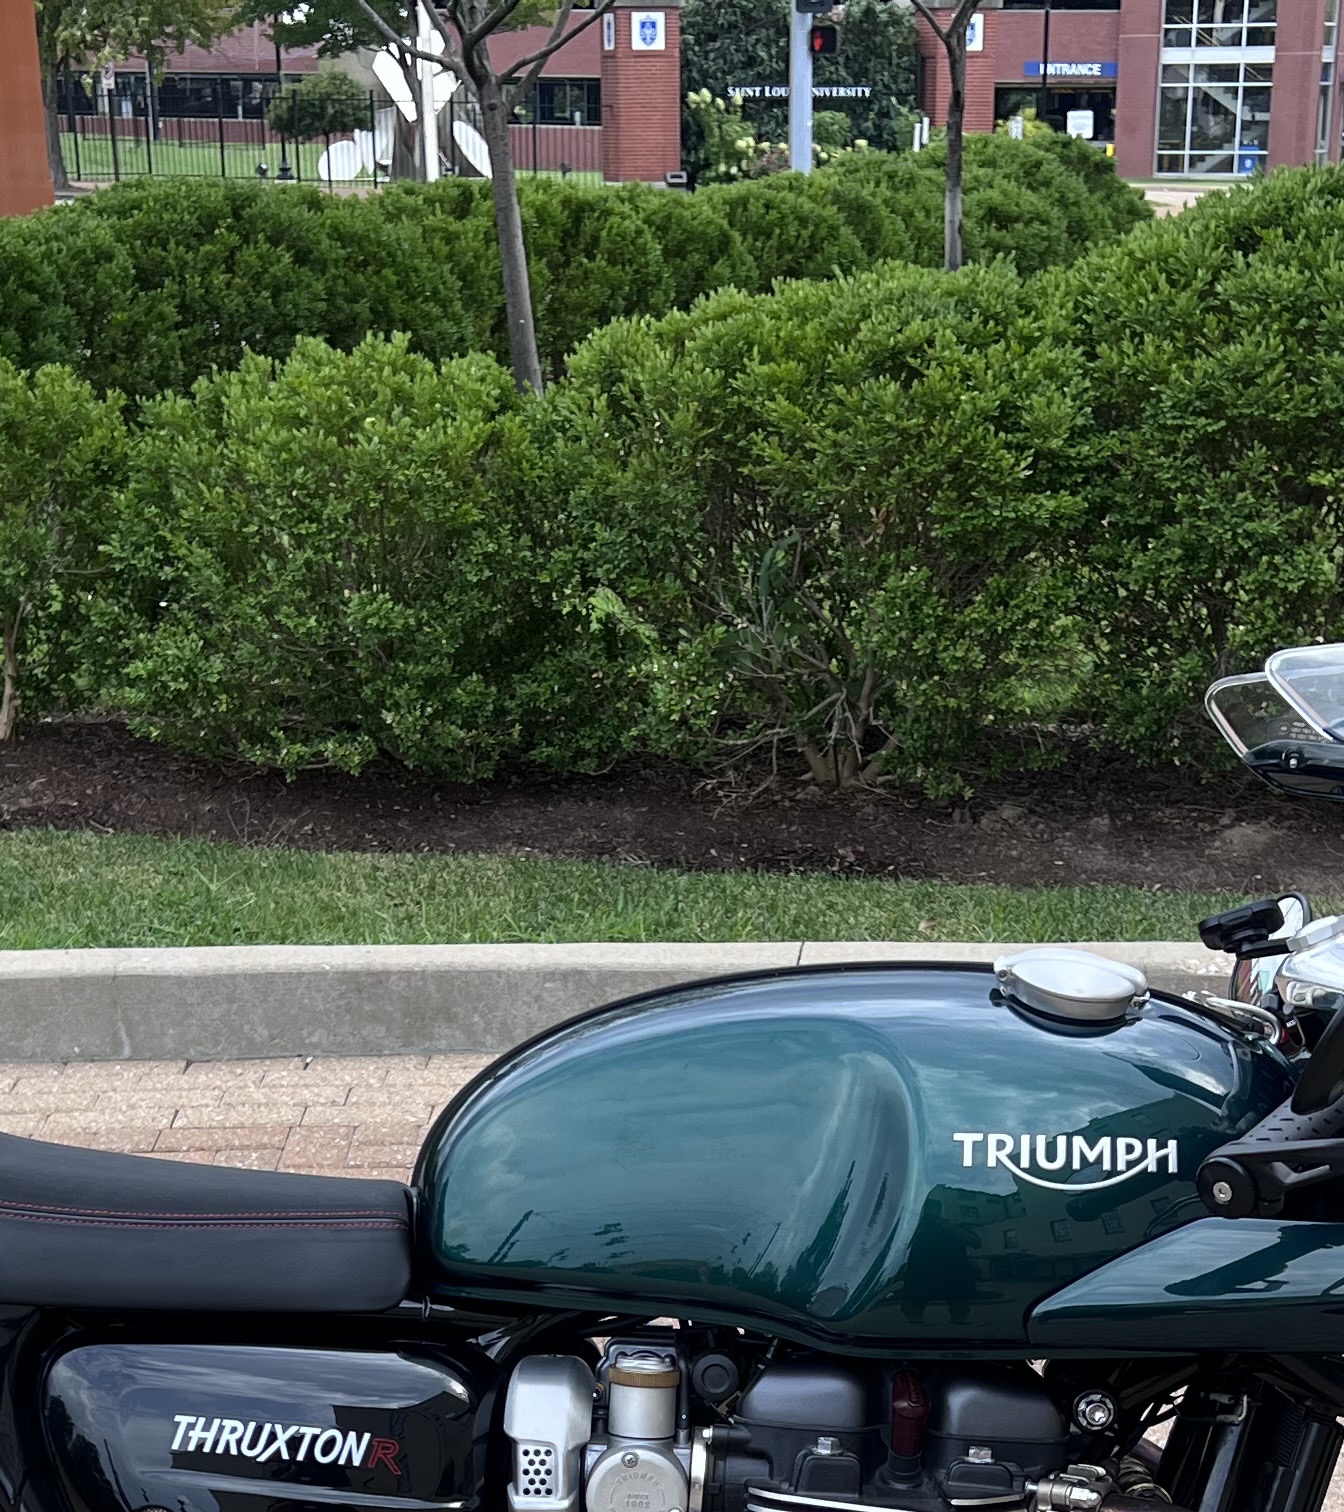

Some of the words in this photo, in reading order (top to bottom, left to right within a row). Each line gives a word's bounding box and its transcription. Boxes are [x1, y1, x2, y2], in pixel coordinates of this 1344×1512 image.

[727, 86, 762, 98] SAINT
[764, 86, 790, 98] LOU
[811, 87, 872, 98] NIVERSITY
[952, 1132, 1178, 1191] TRIUMPH
[170, 1414, 372, 1468] THRUXTON
[367, 1437, 403, 1476] R
